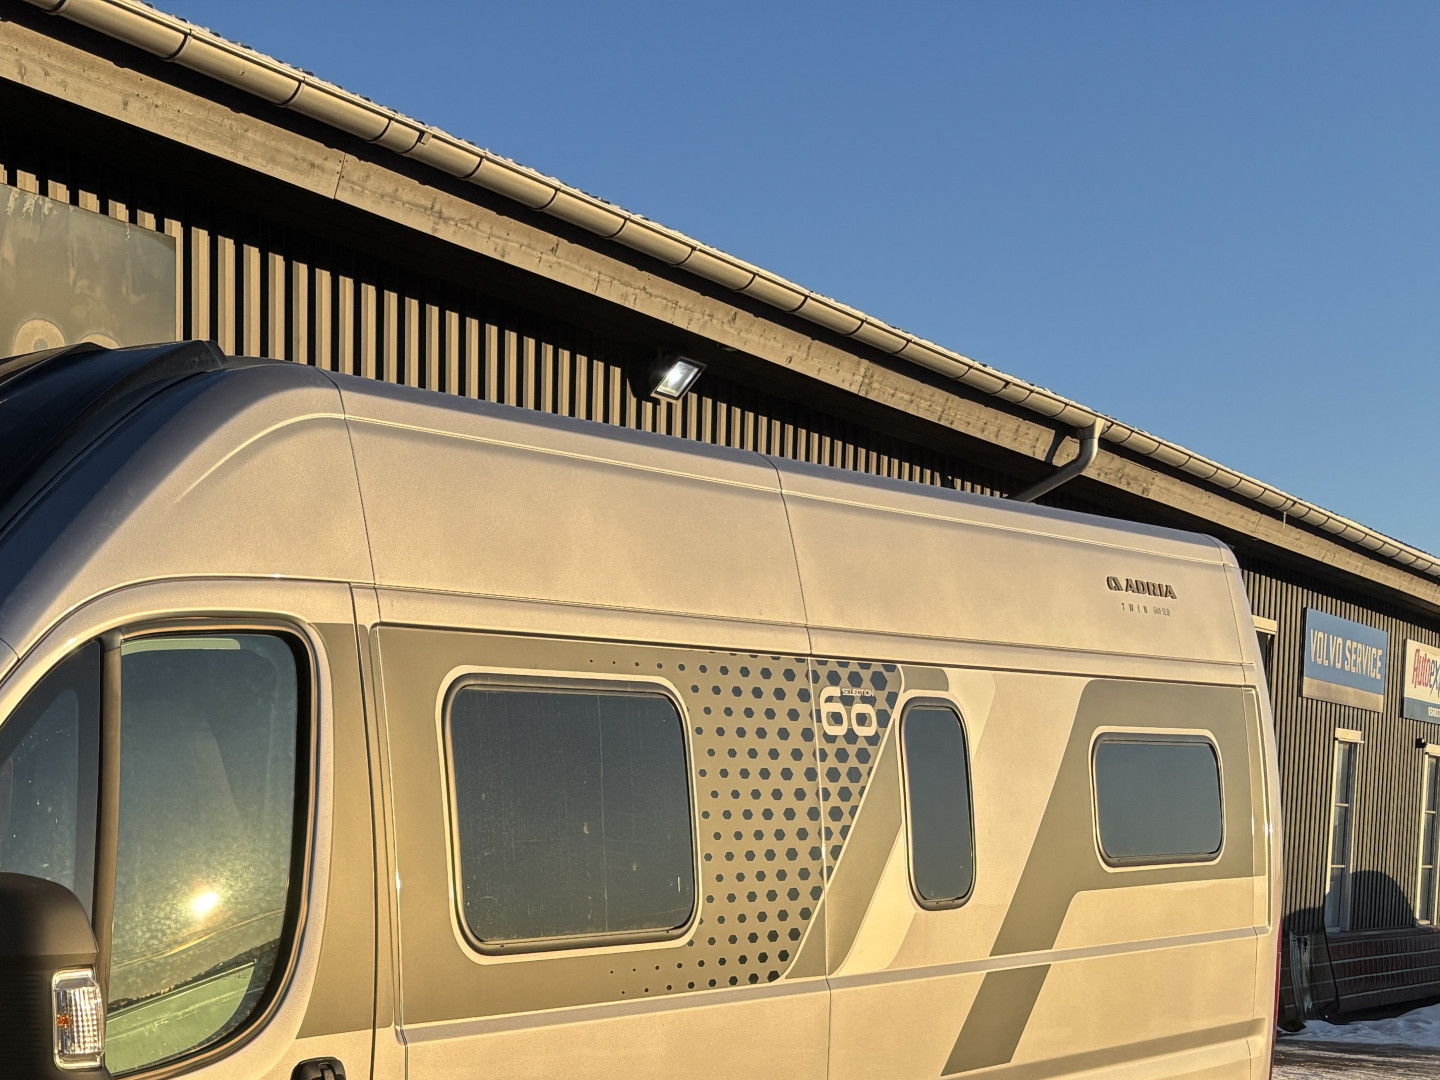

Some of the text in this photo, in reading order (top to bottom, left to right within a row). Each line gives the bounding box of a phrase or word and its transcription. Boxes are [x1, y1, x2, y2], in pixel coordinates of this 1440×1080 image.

[1125, 578, 1177, 599] ADRIA
[1310, 628, 1383, 680] VOLVO SERVICE
[841, 688, 875, 697] SELECTION
[819, 686, 877, 736] 60
